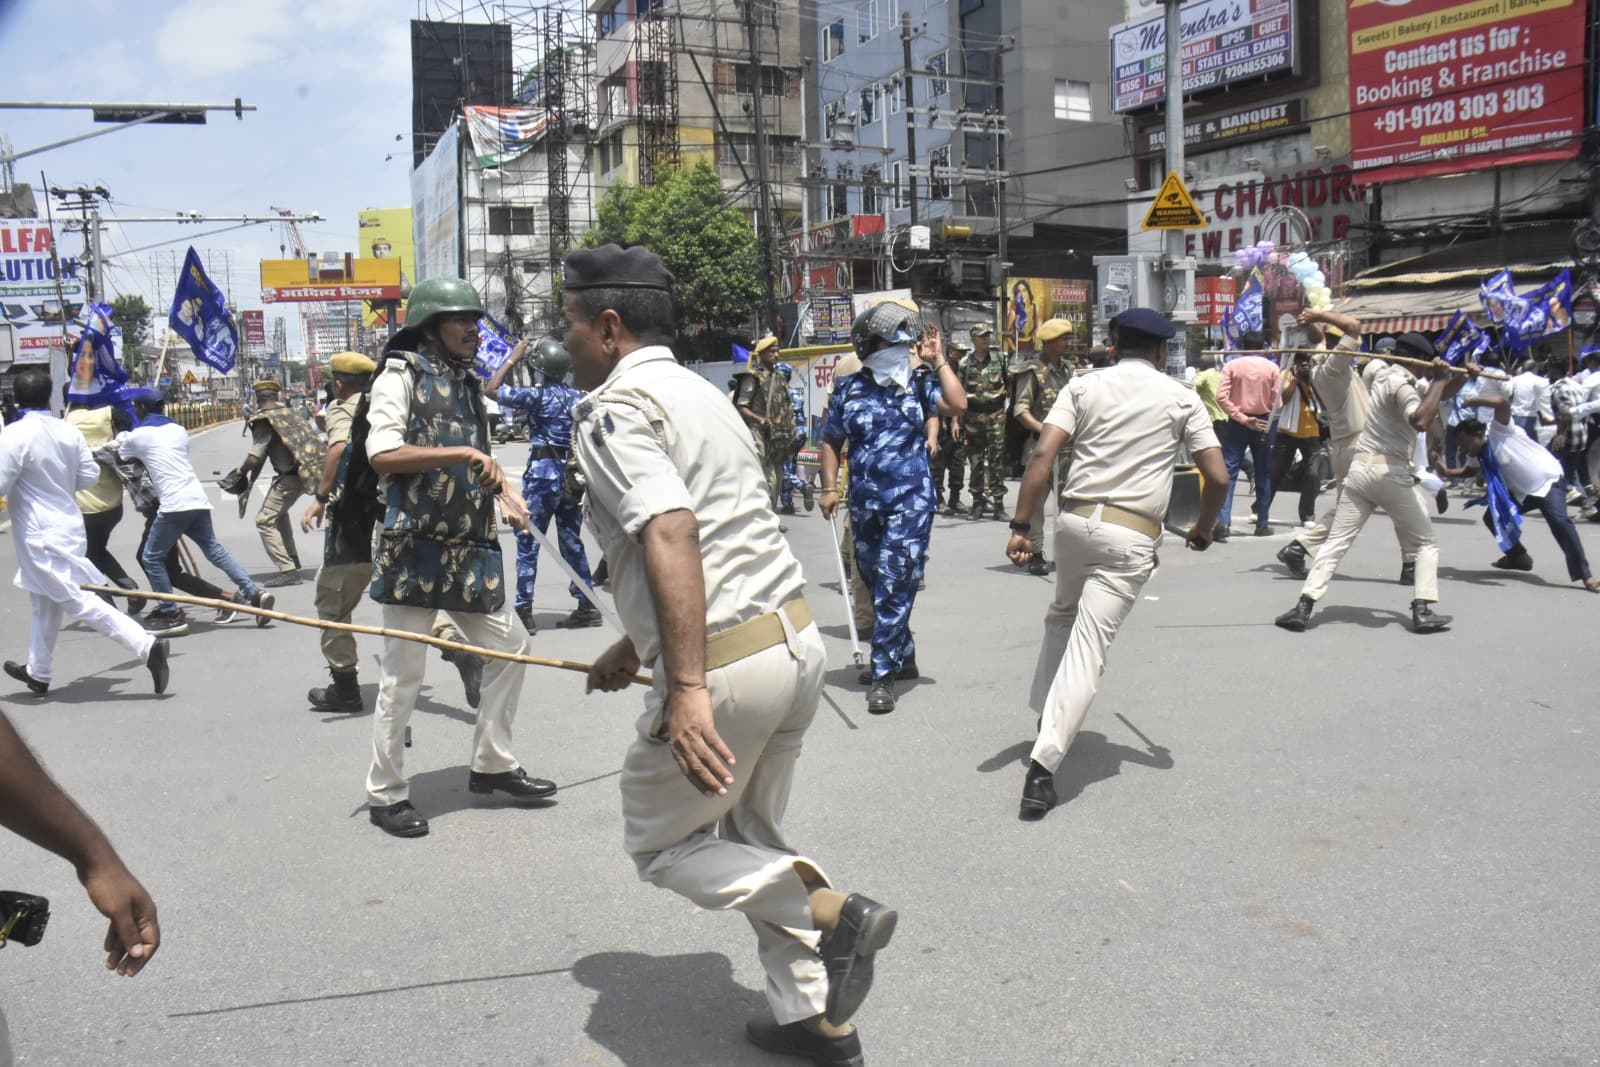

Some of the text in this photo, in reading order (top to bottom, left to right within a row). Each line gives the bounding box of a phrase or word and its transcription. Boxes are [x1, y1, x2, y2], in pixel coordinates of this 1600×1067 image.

[1357, 31, 1390, 46] Sweets
[1398, 20, 1432, 37] Bakery
[1440, 4, 1499, 26] Restaurant
[1119, 62, 1140, 79] BANK
[1222, 30, 1246, 47] BPSC
[1259, 17, 1283, 35] CUET
[1120, 79, 1140, 94] BSSC
[1197, 54, 1223, 71] STATE
[1225, 46, 1251, 62] LEVEL
[1252, 36, 1286, 56] EXAMS
[1225, 54, 1285, 79] 9204855306
[1385, 38, 1457, 73] Contact
[1461, 32, 1485, 58] us
[1489, 25, 1521, 52] for
[1357, 48, 1567, 104] Booking & Franchise
[1206, 122, 1216, 133] &
[1221, 104, 1289, 130] BANQUET
[1374, 84, 1544, 133] +91-9128 303 303
[1420, 128, 1469, 146] AVAILABLE
[0, 228, 52, 253] LFA
